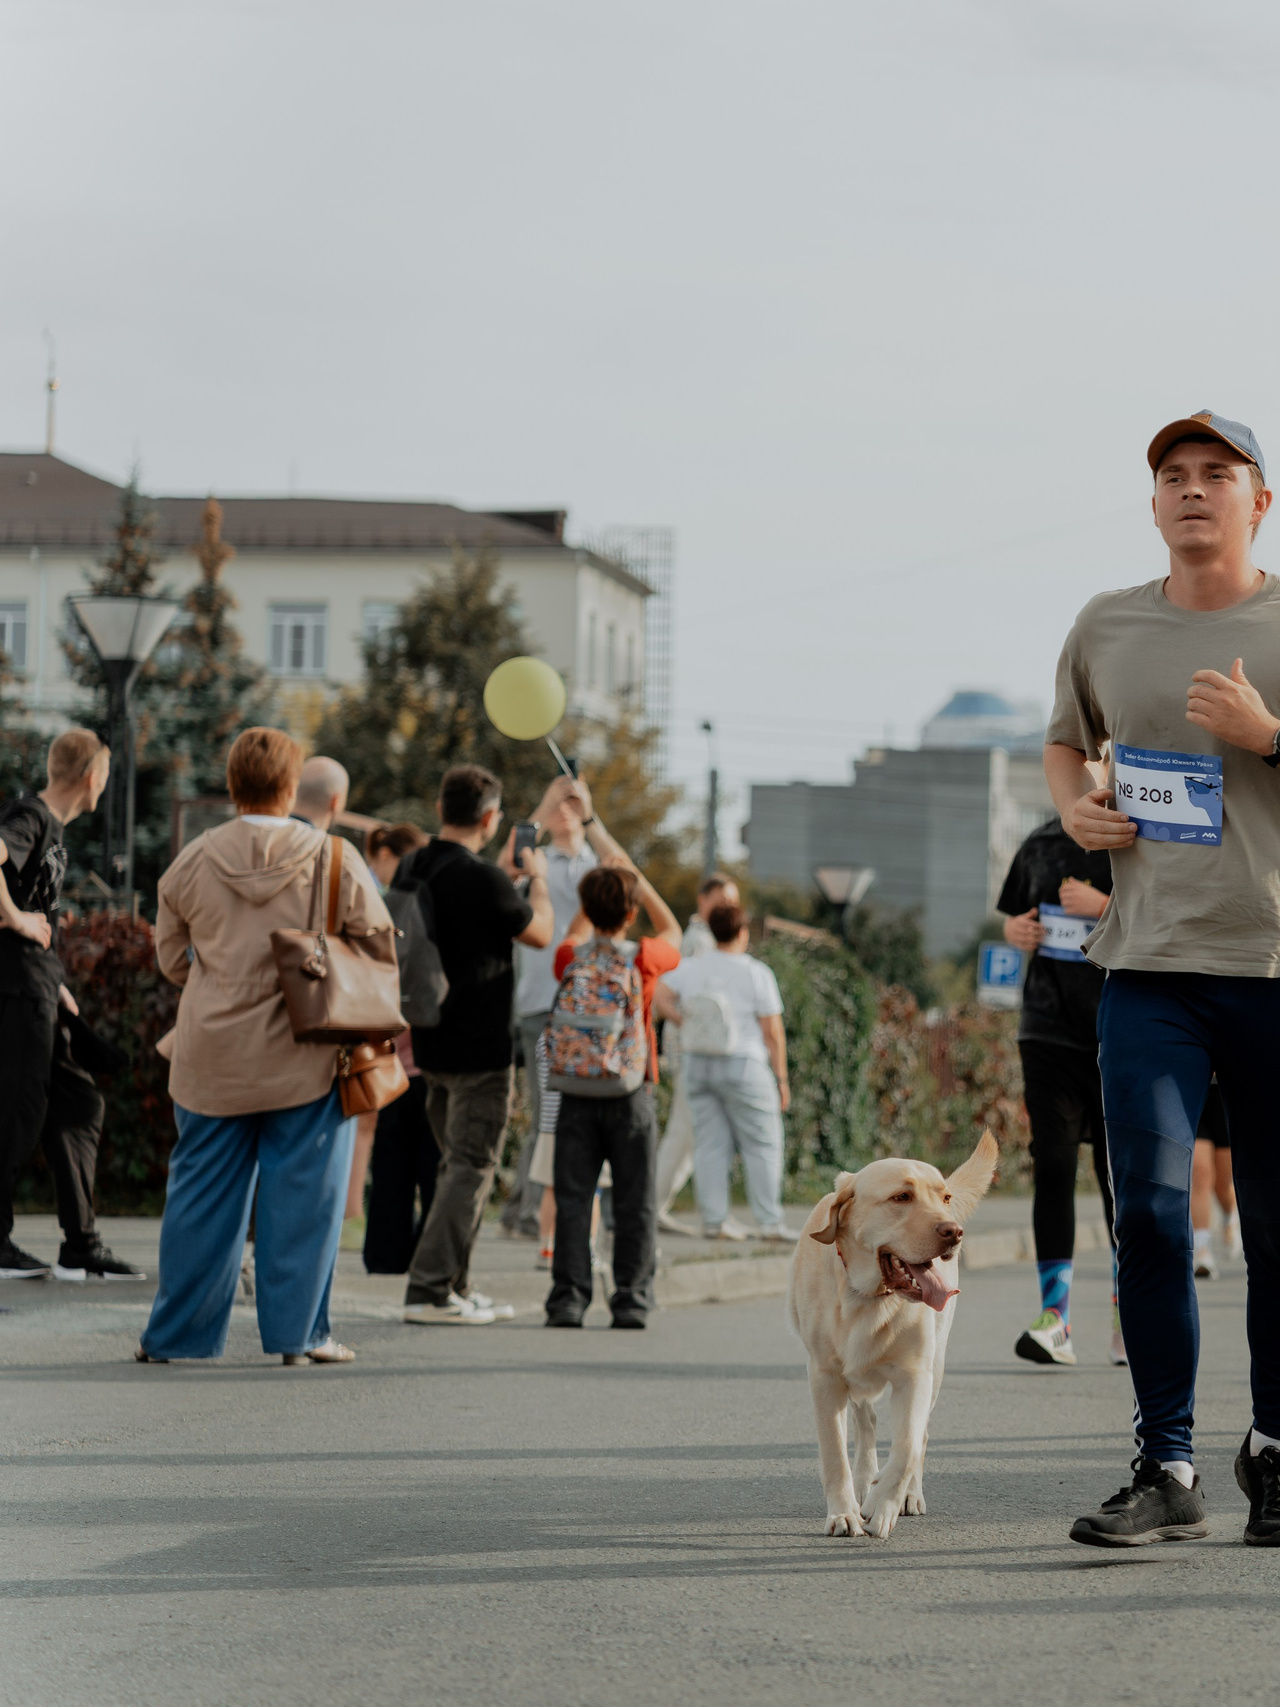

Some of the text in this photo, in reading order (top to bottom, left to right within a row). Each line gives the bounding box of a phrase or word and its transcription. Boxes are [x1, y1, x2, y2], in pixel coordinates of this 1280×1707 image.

[1124, 752, 1137, 760] Забег
[1171, 757, 1196, 766] Южного
[1139, 786, 1173, 805] 208
